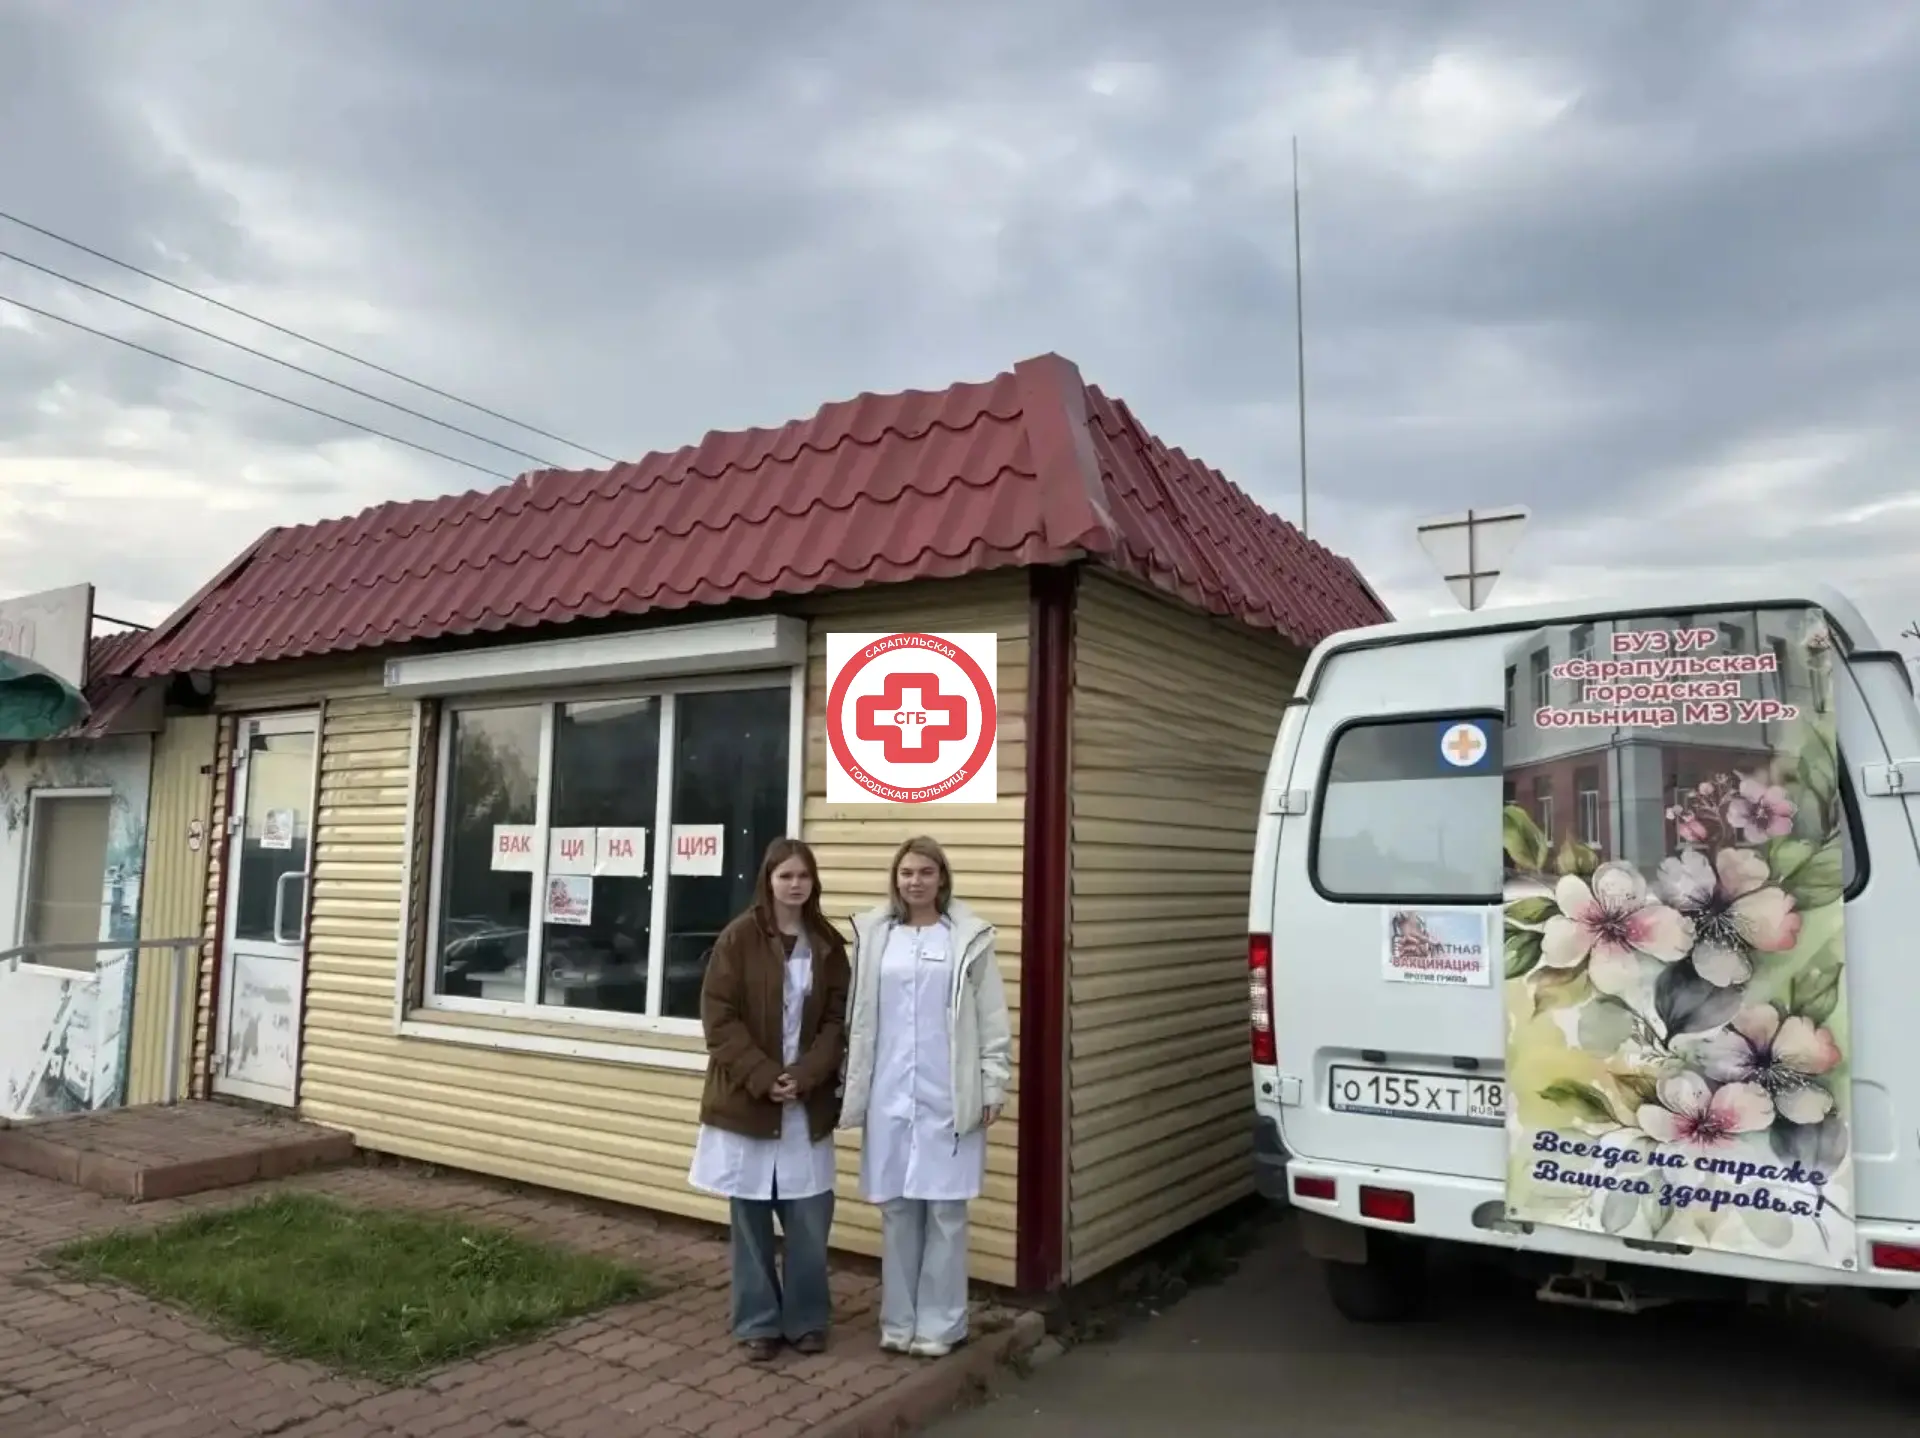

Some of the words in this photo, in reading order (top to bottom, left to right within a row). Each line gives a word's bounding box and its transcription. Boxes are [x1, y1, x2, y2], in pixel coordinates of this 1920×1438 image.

[1612, 632, 1669, 653] БУЗ
[1675, 628, 1716, 650] УР
[1552, 653, 1776, 680] «Сарапульская
[1584, 681, 1740, 703] городская
[1535, 706, 1677, 728] больница
[1683, 702, 1730, 723] МЗ
[1735, 700, 1798, 723] УР»
[499, 835, 531, 853] ВАК
[560, 839, 585, 861] ЦИ
[609, 839, 633, 857] НА
[677, 836, 718, 861] ЦИЯ
[1391, 956, 1480, 973] ВАКЦИНАЦИЯ
[1471, 1105, 1494, 1116] RUS
[1532, 1130, 1642, 1169] Всегда
[1647, 1151, 1688, 1168] на
[1694, 1157, 1828, 1187] страже
[1532, 1159, 1653, 1195] Вашего
[1659, 1184, 1826, 1218] здоровья!
